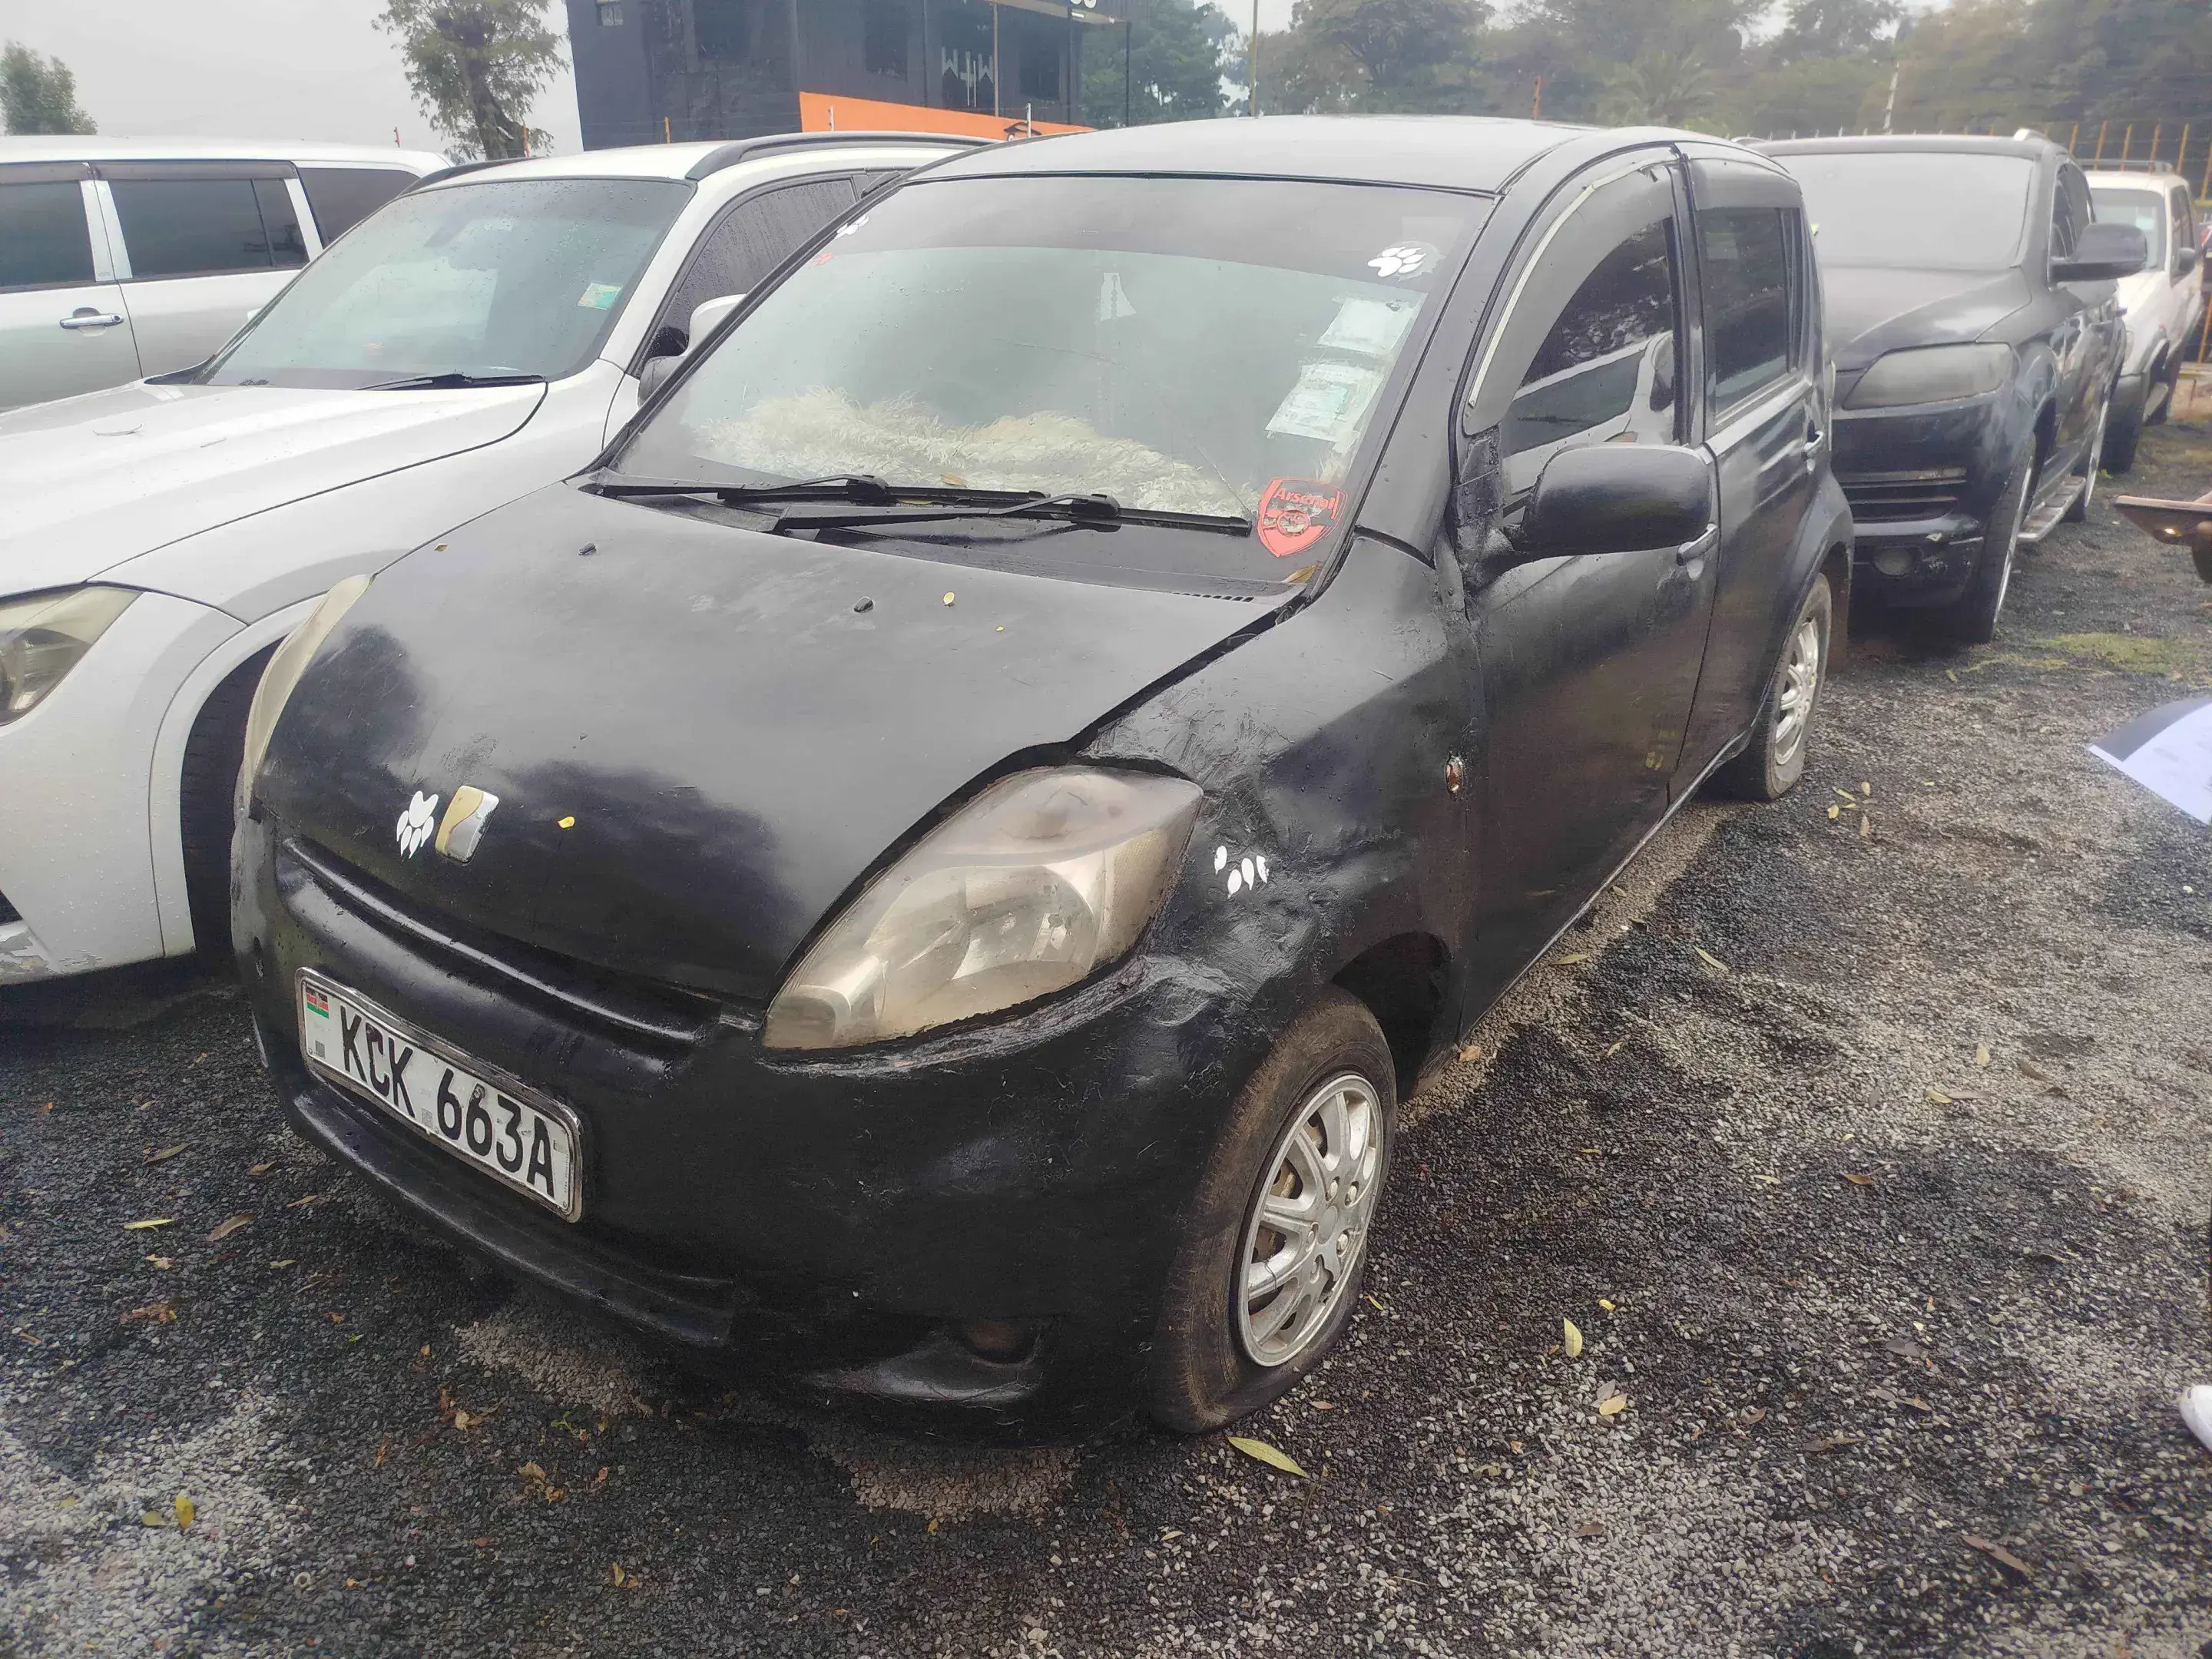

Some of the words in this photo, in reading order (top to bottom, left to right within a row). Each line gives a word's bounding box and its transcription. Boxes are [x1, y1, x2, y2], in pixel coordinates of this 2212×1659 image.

[1273, 487, 1336, 510] Arsenal
[340, 1005, 416, 1118] KCK
[437, 1068, 555, 1199] 663A
